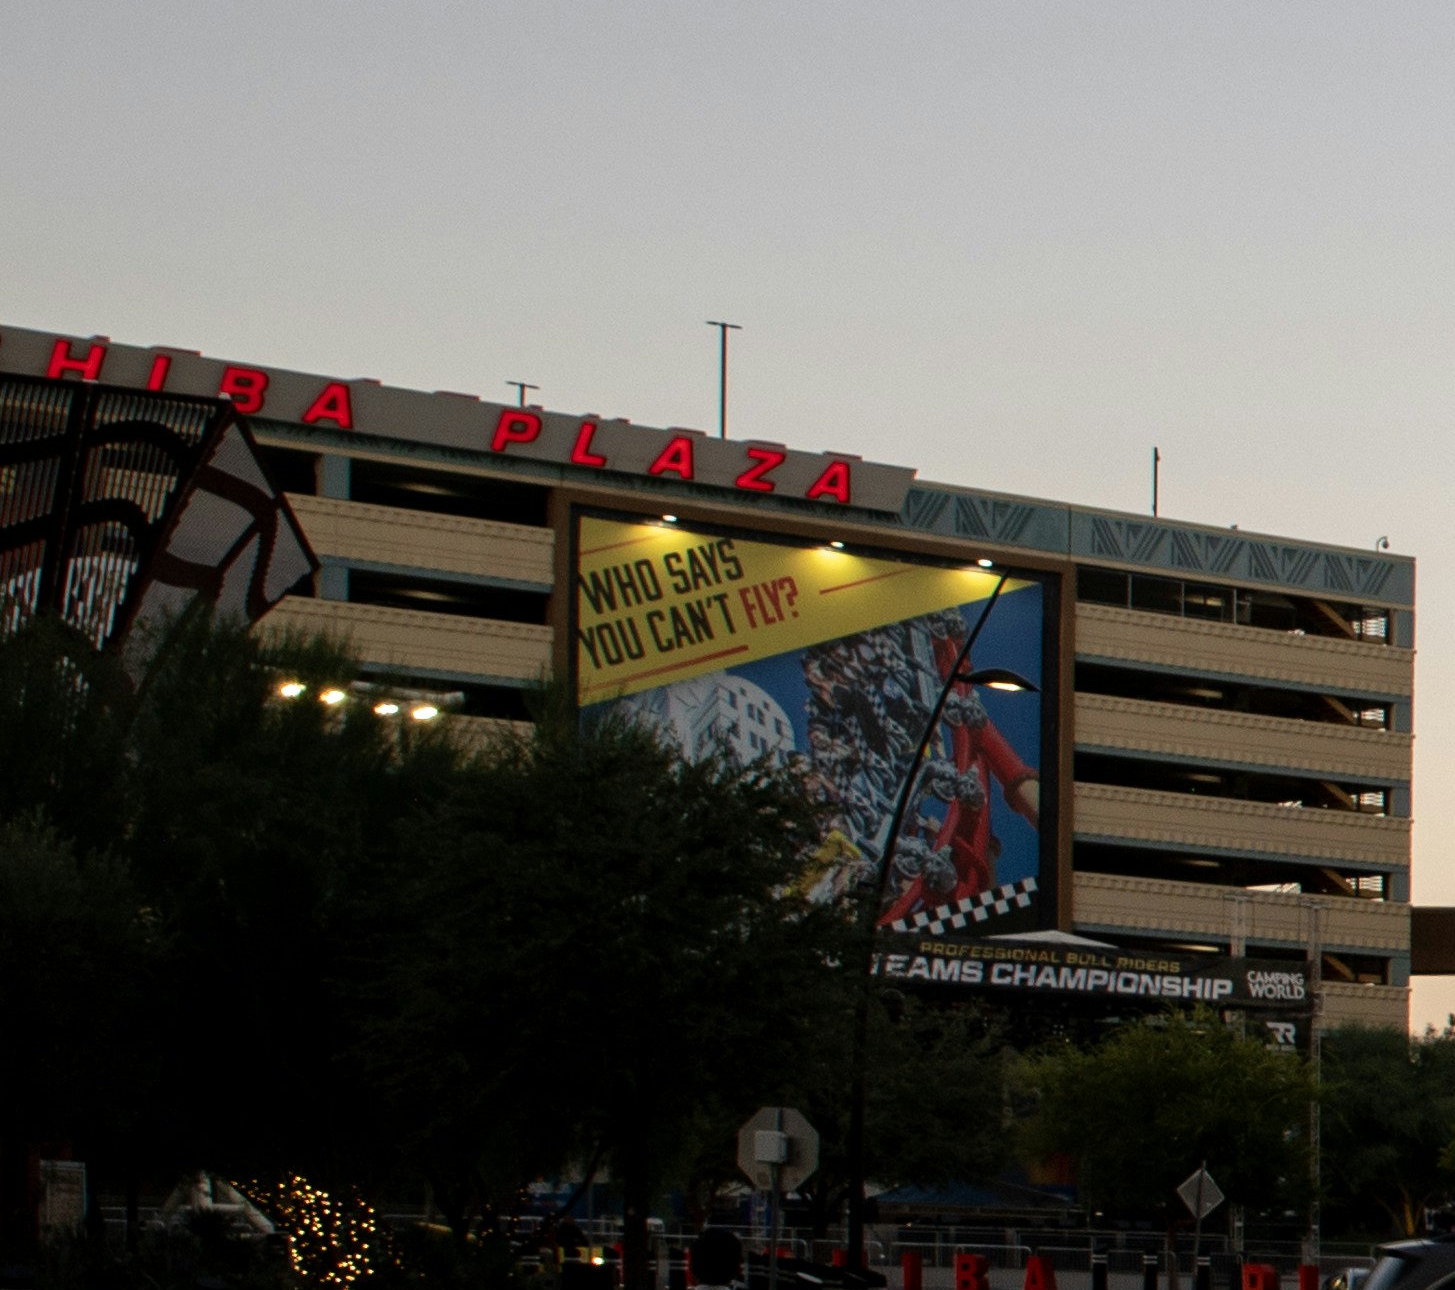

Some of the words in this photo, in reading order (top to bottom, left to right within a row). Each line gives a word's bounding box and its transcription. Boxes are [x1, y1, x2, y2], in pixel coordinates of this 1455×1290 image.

[490, 410, 851, 503] PLAZA
[577, 559, 663, 614] WHO
[664, 538, 744, 594] SAYS
[577, 616, 645, 669] YOU
[647, 592, 736, 652] CAN'T
[738, 576, 798, 629] FLY?
[869, 952, 984, 984] TEAMS
[990, 961, 1233, 1000] CHAMPIONSHIP
[919, 941, 1059, 963] PROFESSIONAL
[1067, 952, 1111, 968] BULL
[1117, 956, 1181, 973] RIDERS
[1247, 970, 1305, 986] CAMPING
[1249, 981, 1306, 1000] WORLD
